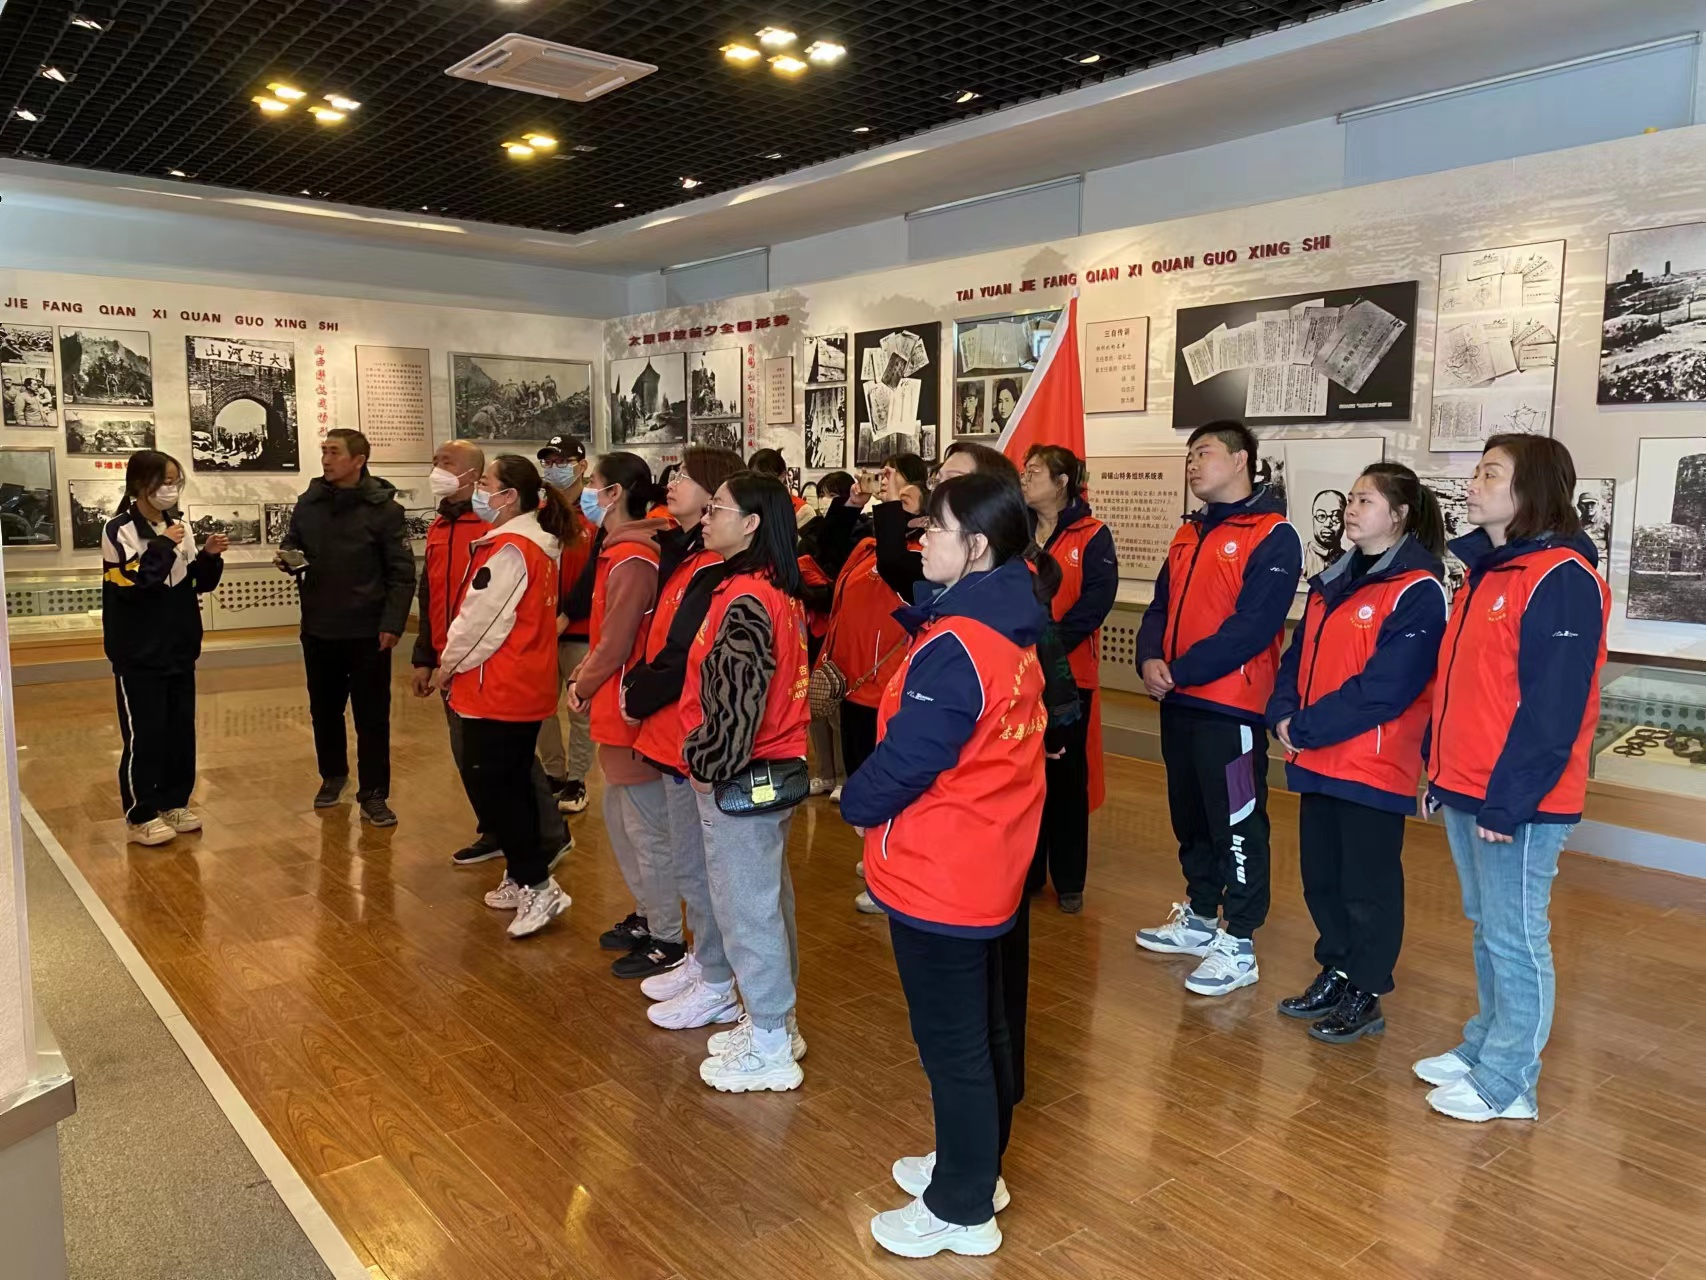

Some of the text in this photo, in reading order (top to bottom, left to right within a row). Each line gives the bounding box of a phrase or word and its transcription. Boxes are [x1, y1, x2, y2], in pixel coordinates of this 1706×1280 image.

[956, 288, 974, 302] TAI
[979, 283, 1012, 298] YUAN
[1043, 273, 1077, 289] FANG
[1085, 267, 1119, 284] QIAN
[1127, 264, 1143, 279] XI
[1151, 256, 1194, 274] QUAN
[1203, 249, 1237, 266] GUO
[1248, 241, 1291, 260] XING
[1302, 234, 1332, 253] SHI
[4, 297, 340, 332] JIE FANG QIAN XI QUAN GUO XING SHI
